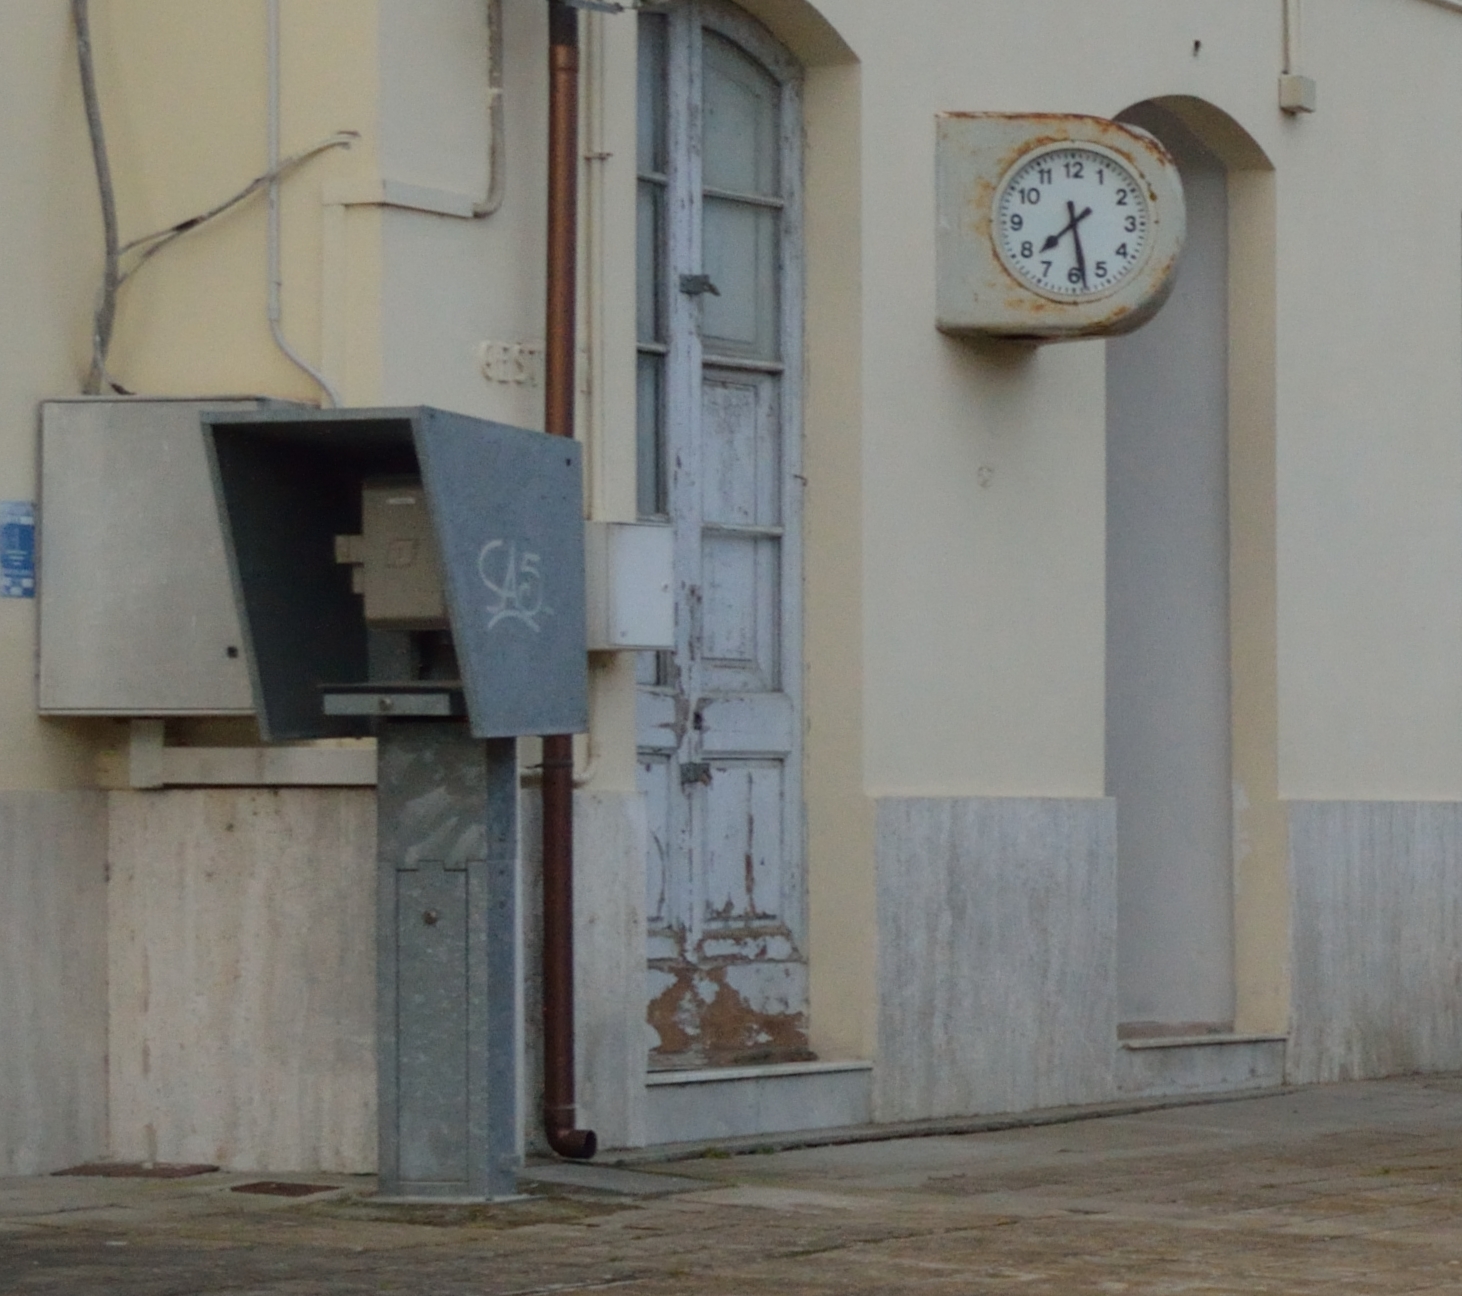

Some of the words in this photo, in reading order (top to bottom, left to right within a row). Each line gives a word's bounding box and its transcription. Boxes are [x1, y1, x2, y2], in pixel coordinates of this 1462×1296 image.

[1039, 169, 1052, 184] 11
[1063, 162, 1083, 179] 12
[1096, 170, 1105, 184] 1
[1019, 188, 1040, 204] 10
[1116, 190, 1128, 206] 2
[1011, 214, 1022, 231] 9
[1125, 216, 1136, 232] 3
[1021, 242, 1033, 258] 8
[1116, 243, 1128, 259] 4
[1041, 261, 1052, 277] 7
[1068, 268, 1082, 284] 6
[1096, 262, 1107, 277] 5
